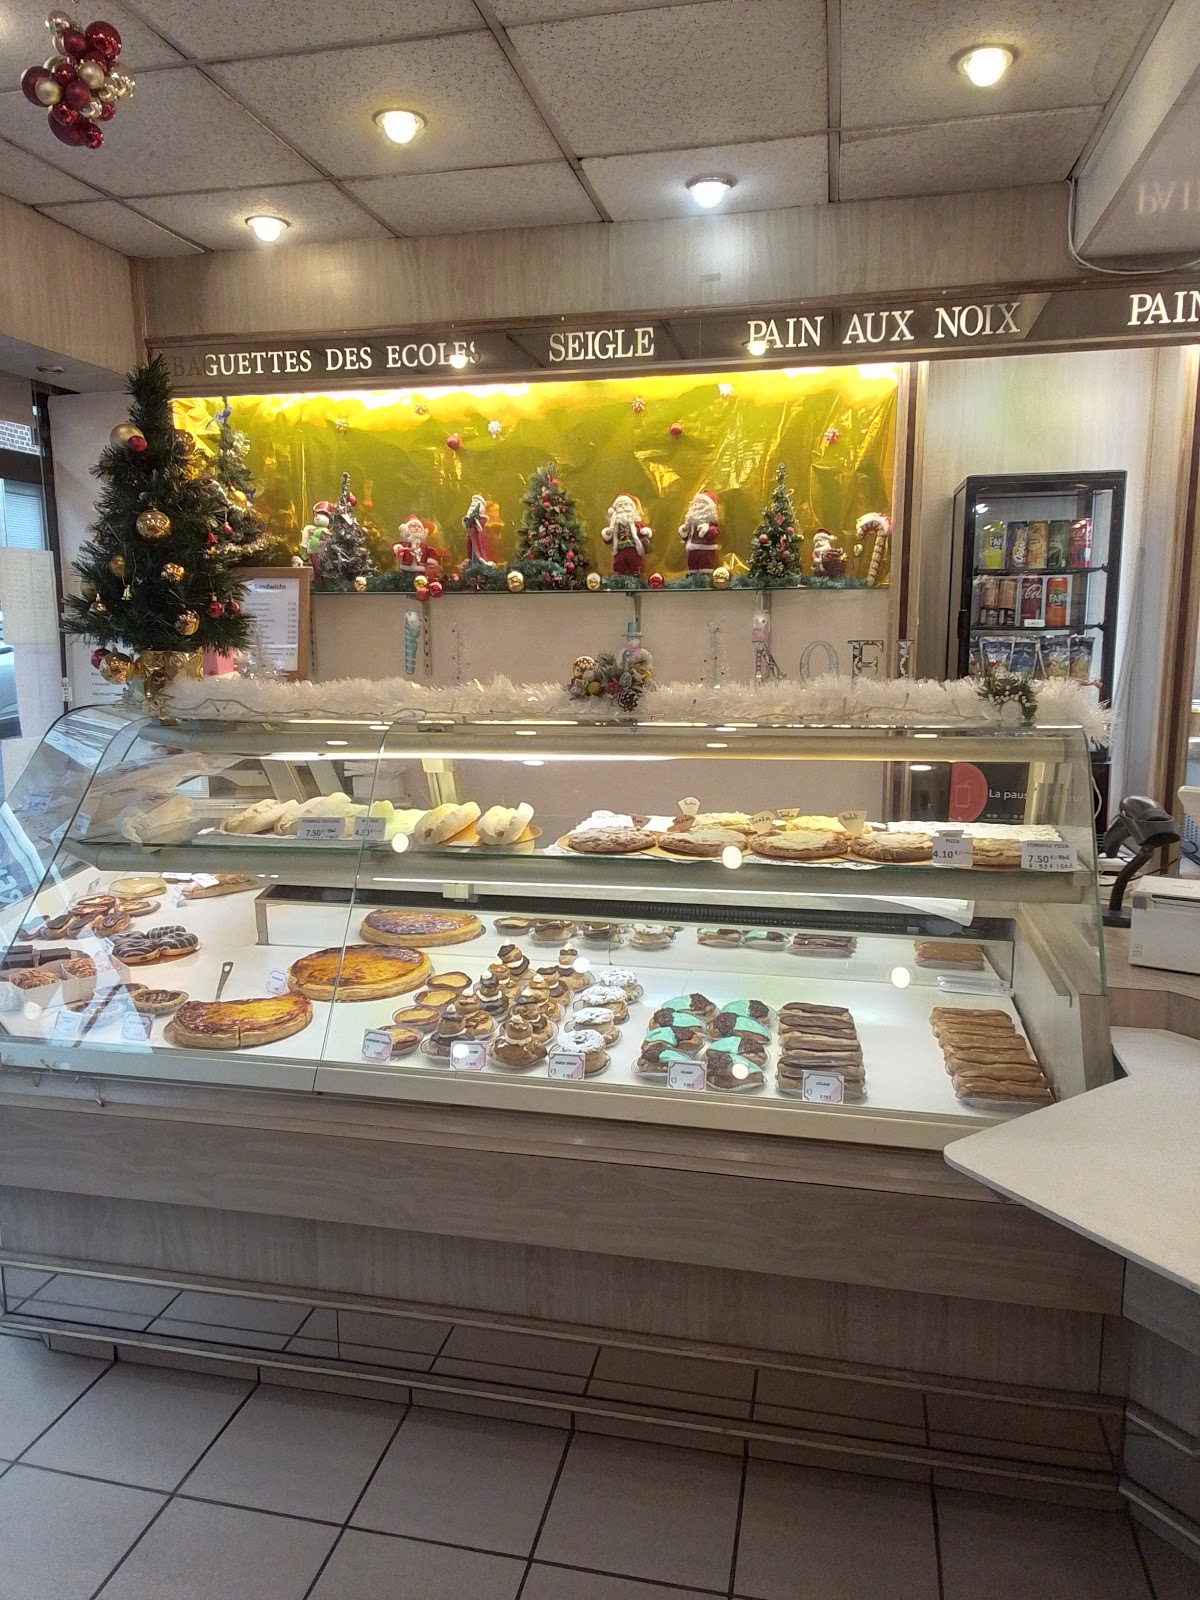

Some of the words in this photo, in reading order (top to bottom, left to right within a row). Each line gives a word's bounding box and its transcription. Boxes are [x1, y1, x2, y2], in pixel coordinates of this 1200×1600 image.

[746, 316, 824, 350] PAIN
[842, 309, 914, 345] AUX
[934, 302, 1021, 339] NOIX
[172, 350, 312, 378] BAGUETTES
[325, 346, 373, 371] DES
[386, 341, 481, 369] ECOLES
[549, 327, 655, 362] SEIGLE
[989, 789, 1001, 798] La
[1003, 791, 1028, 800] paus
